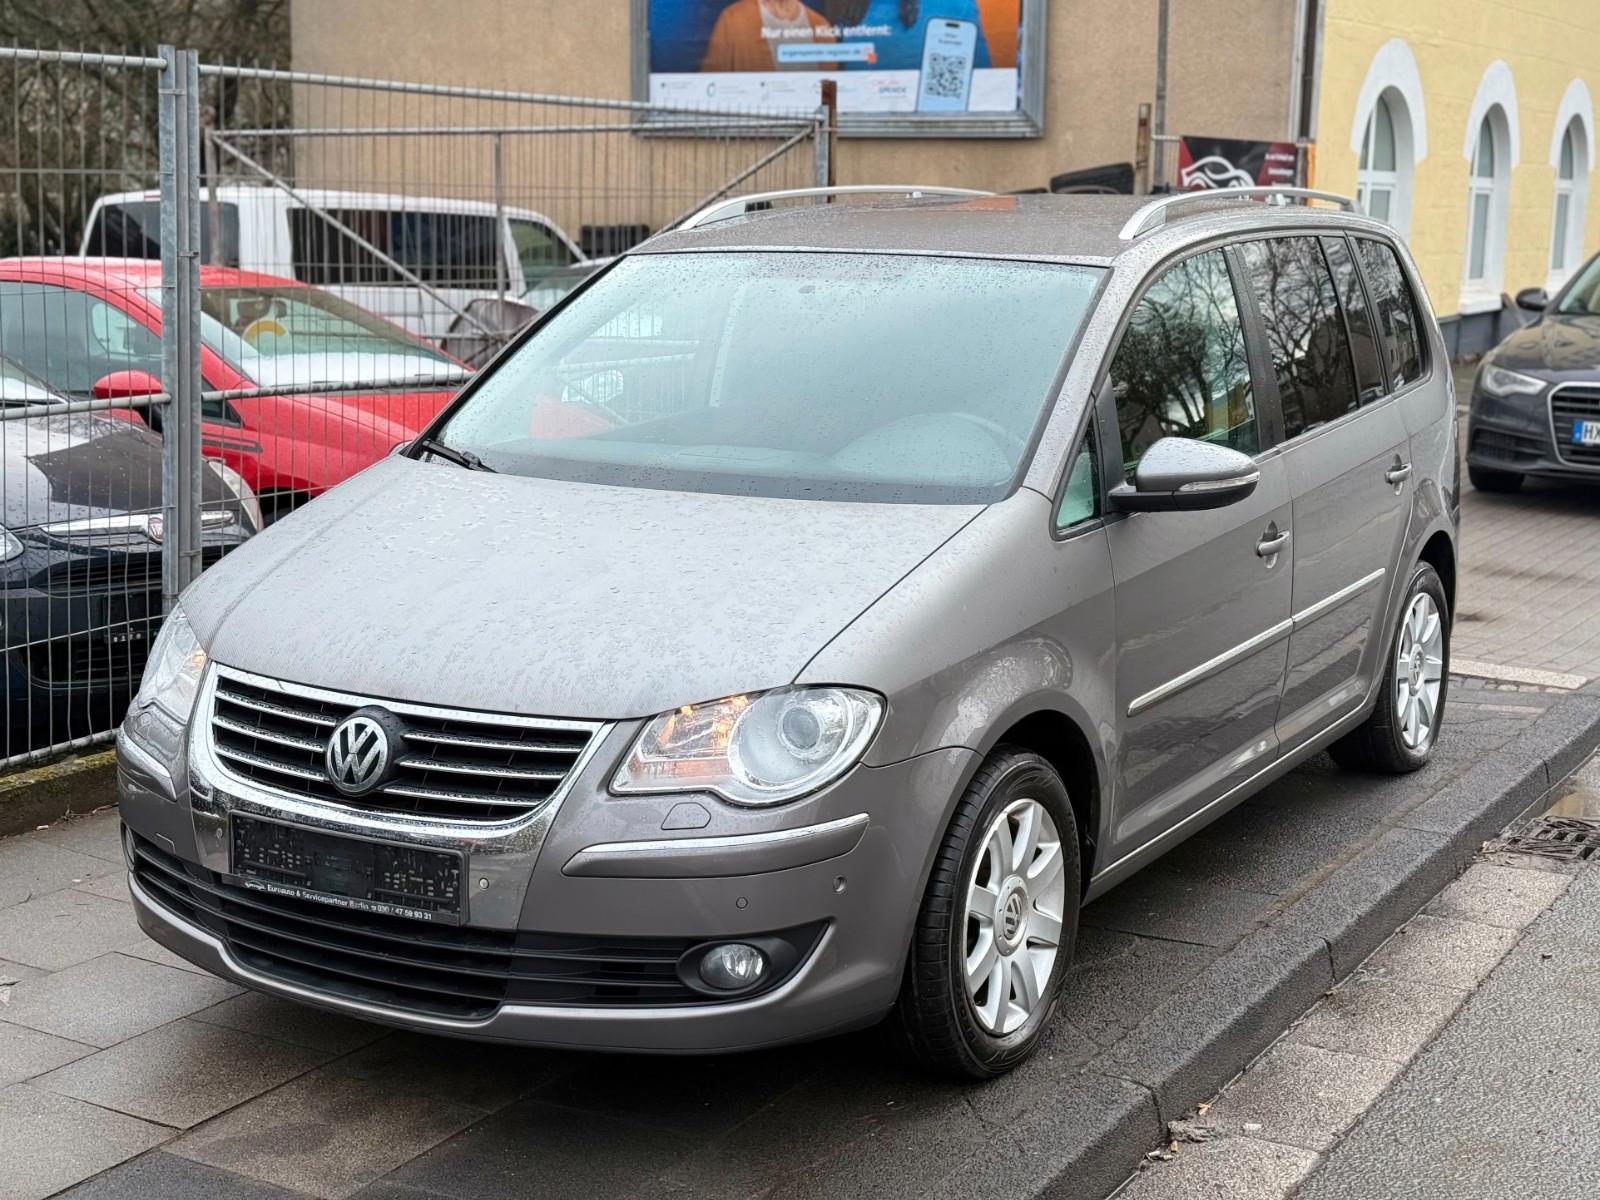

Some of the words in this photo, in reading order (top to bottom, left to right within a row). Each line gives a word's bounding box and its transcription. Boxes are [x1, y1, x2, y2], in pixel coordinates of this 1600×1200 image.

[761, 26, 783, 38] Nur
[783, 27, 814, 38] einen
[815, 25, 842, 37] Klick
[843, 24, 892, 37] entfernt:
[328, 717, 388, 792] VW
[295, 889, 301, 897] &
[302, 891, 348, 906] Servicepartner
[414, 911, 423, 919] 93
[423, 912, 432, 920] 31
